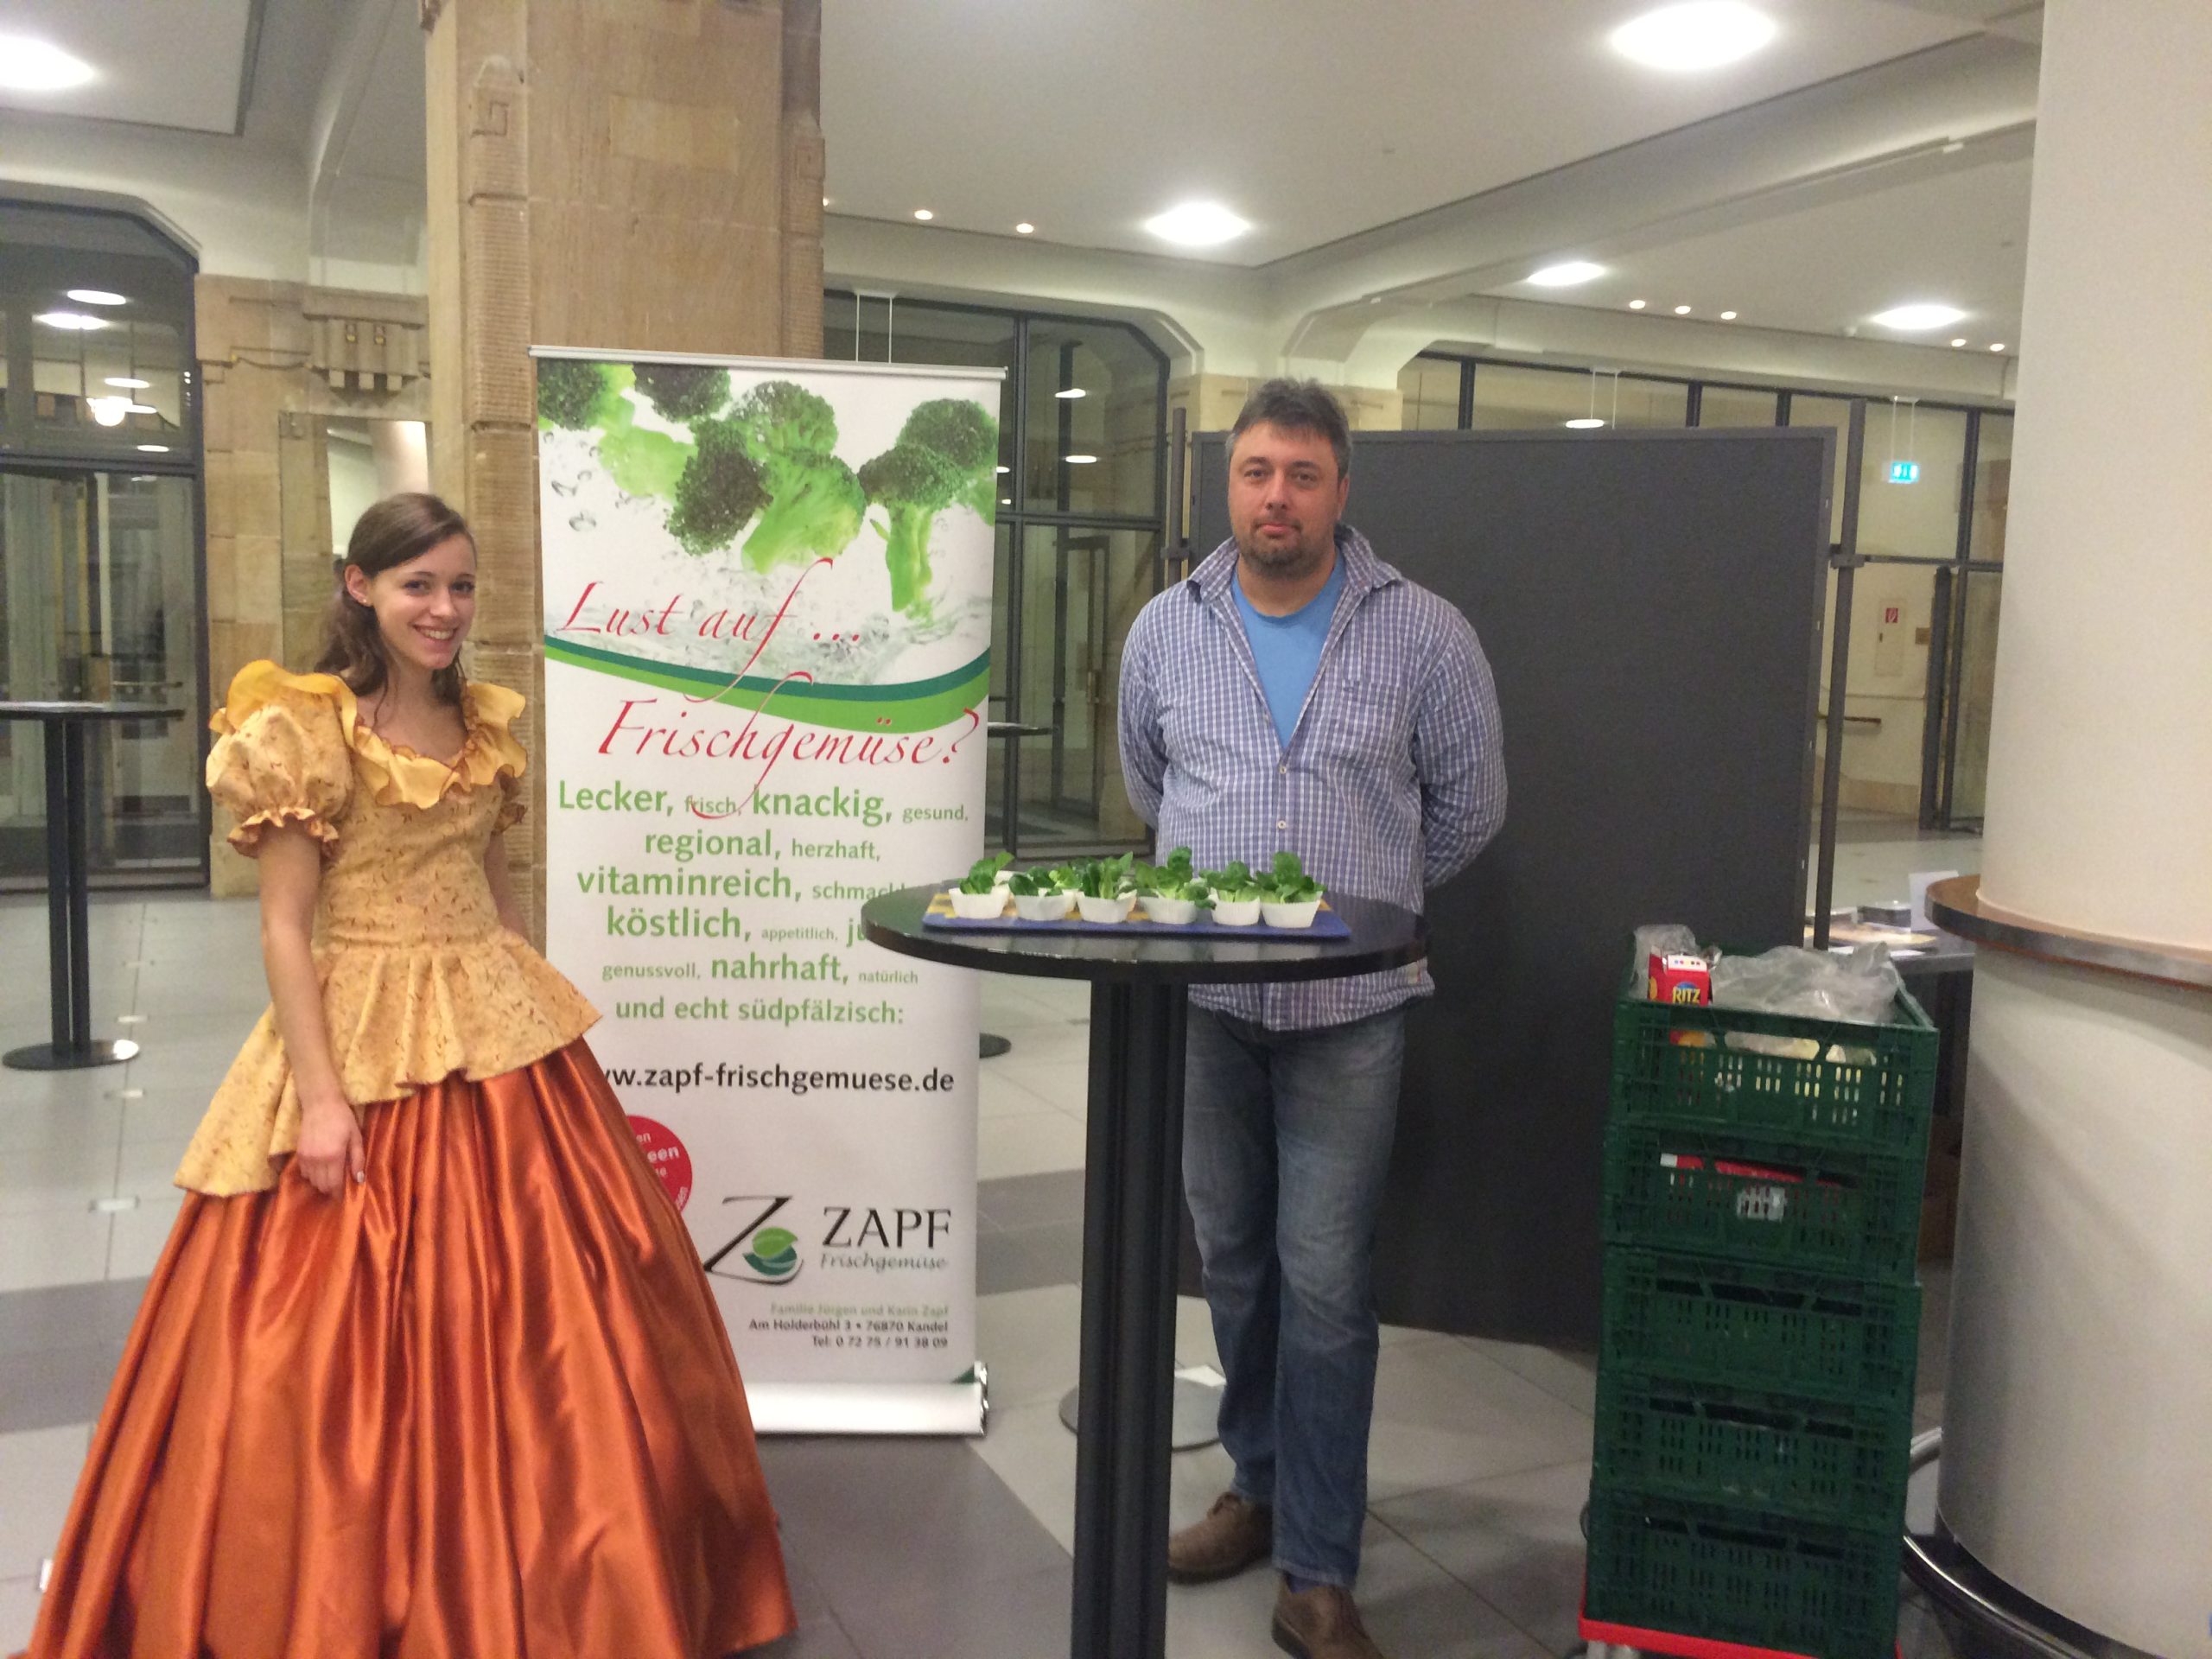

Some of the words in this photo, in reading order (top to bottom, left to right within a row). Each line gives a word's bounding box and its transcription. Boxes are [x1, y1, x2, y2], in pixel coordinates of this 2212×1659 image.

[556, 581, 685, 636] Lust
[683, 557, 834, 703] auf
[597, 671, 980, 819] Frischgemüse?
[559, 779, 673, 817] Lecker,
[684, 794, 742, 816] frisch,
[753, 784, 892, 827] knackig,
[902, 804, 969, 823] gesund,
[645, 828, 781, 862] regional,
[791, 837, 880, 861] herzhaft,
[576, 865, 802, 902] vitaminreich,
[607, 905, 751, 942] köstlich,
[760, 926, 839, 942] appetitlich,
[601, 963, 702, 982] genussvoll,
[711, 951, 849, 985] nahrhaft,
[858, 970, 919, 985] natürlich
[616, 996, 664, 1020] und
[674, 997, 729, 1020] echt
[739, 998, 905, 1027] südpfälzisch:
[1672, 986, 1700, 1004] RITZ
[822, 1205, 951, 1249] ZAPF
[749, 1319, 769, 1330] Am
[907, 1321, 948, 1332] Kandel
